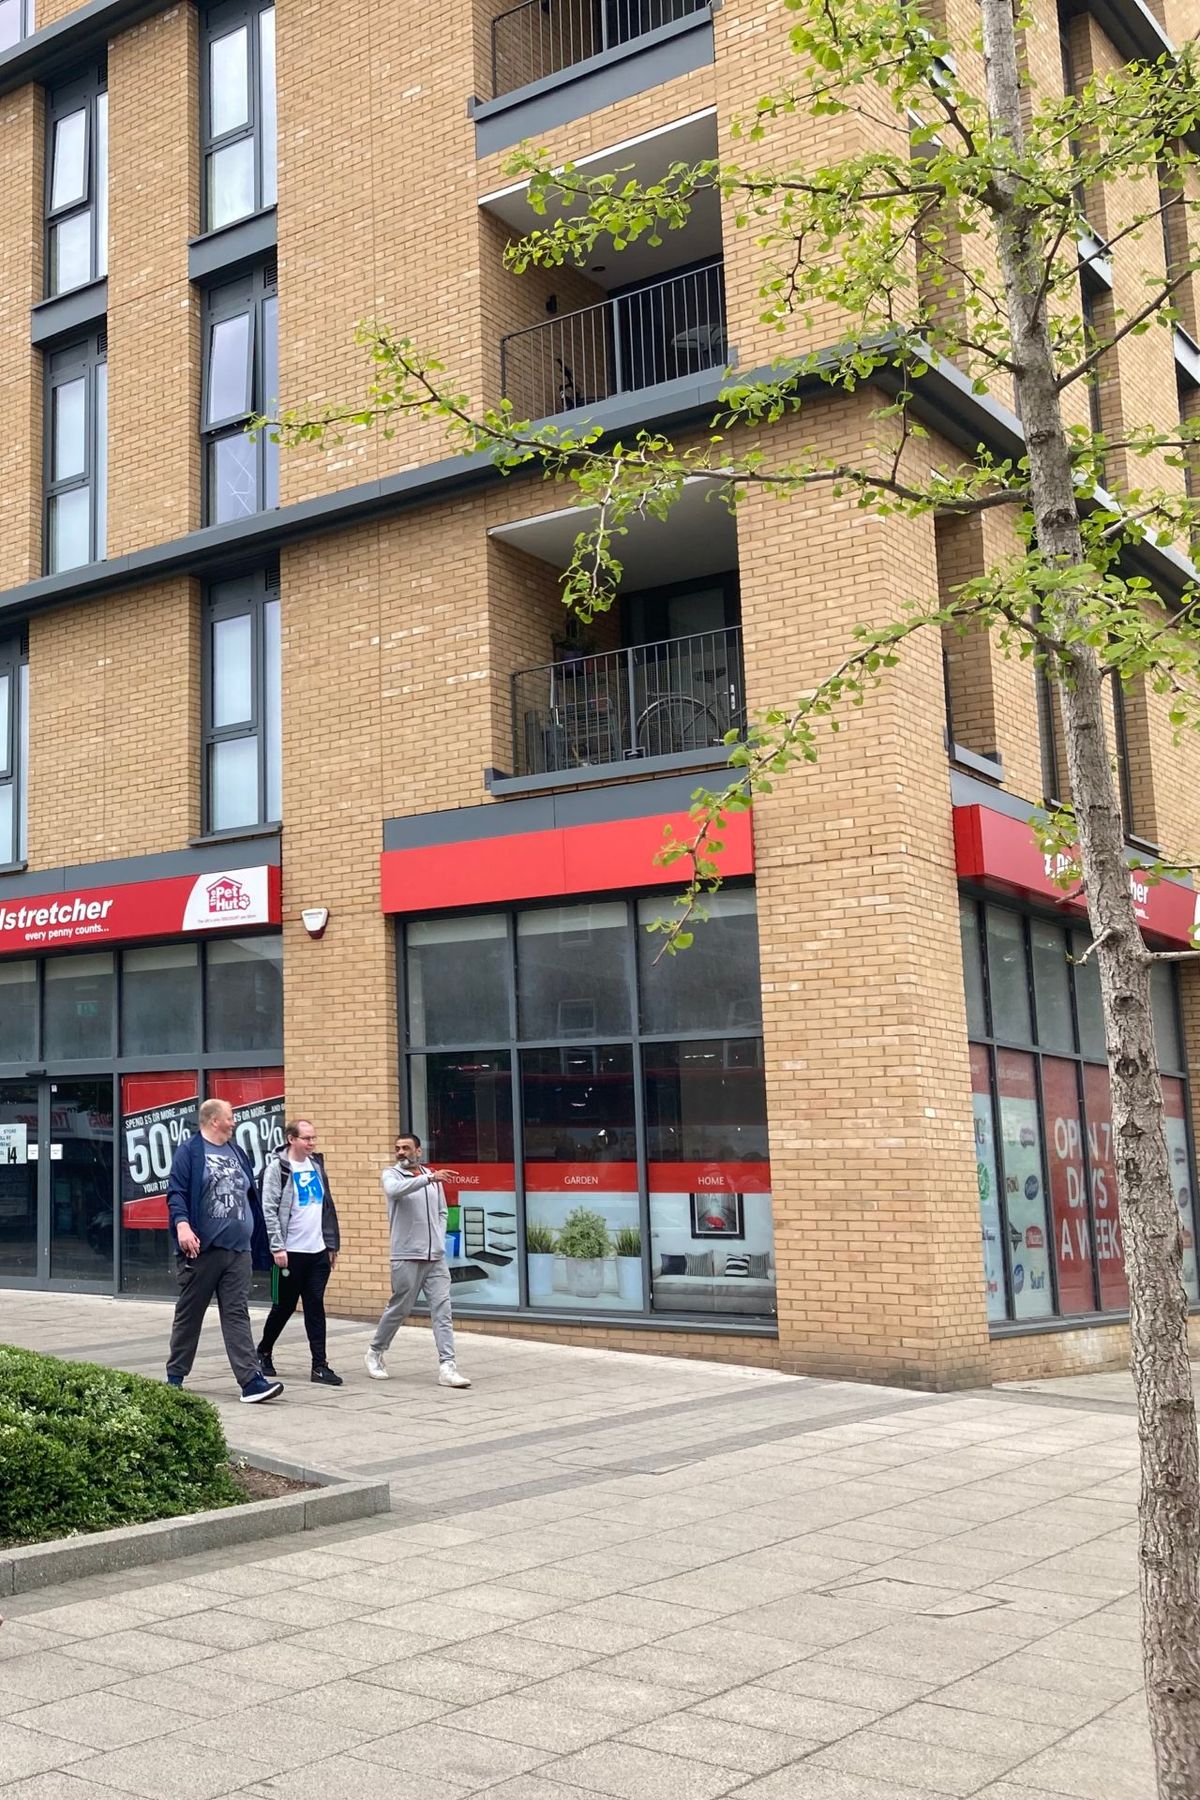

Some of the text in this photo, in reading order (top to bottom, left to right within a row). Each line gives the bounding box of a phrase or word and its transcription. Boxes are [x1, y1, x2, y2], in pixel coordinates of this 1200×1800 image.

[216, 886, 239, 899] Pet
[216, 897, 239, 911] Hut
[25, 931, 46, 941] every
[48, 928, 73, 940] penny
[125, 1116, 144, 1129] SPEND
[144, 1114, 152, 1124] £5
[152, 1112, 160, 1122] OR
[241, 1110, 250, 1120] OR
[235, 1115, 285, 1177] 0%
[1101, 1122, 1111, 1162] 7
[7, 1146, 17, 1164] 14
[125, 1117, 191, 1184] 50%
[143, 1179, 170, 1194] YOUR TOT
[447, 1176, 480, 1184] STORAGE
[564, 1175, 599, 1185] GARDEN
[697, 1176, 725, 1185] HOME
[225, 1195, 235, 1208] 18
[1061, 1218, 1074, 1260] A
